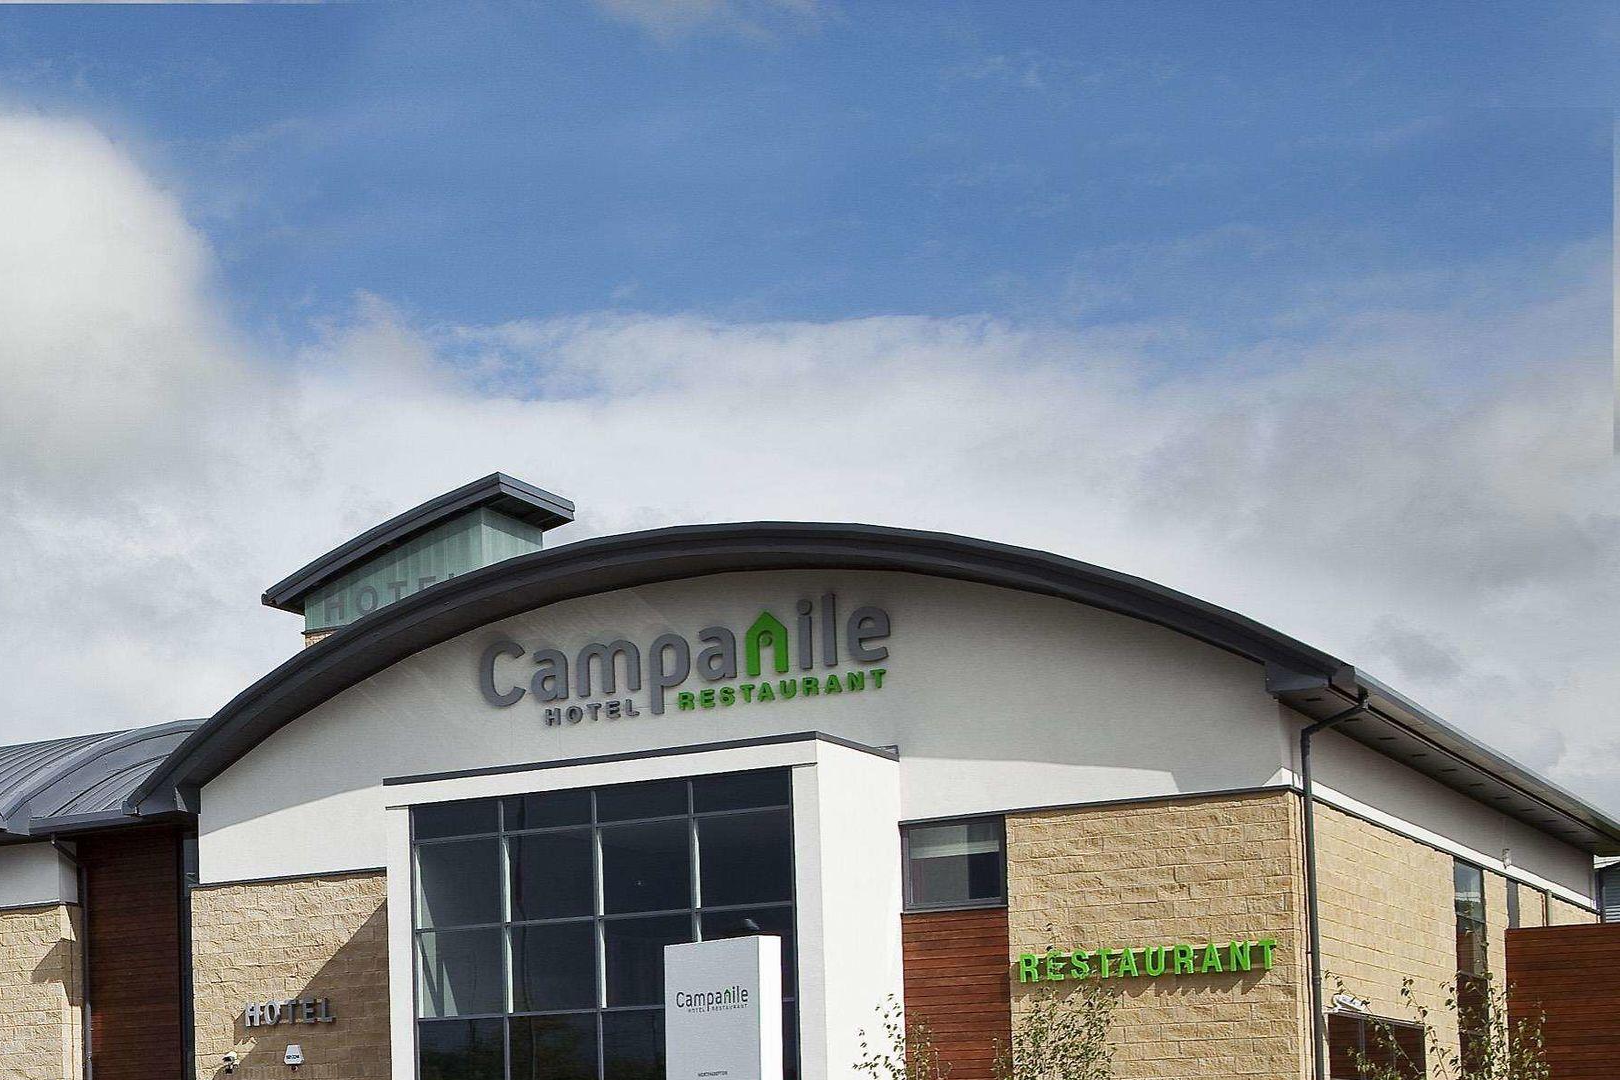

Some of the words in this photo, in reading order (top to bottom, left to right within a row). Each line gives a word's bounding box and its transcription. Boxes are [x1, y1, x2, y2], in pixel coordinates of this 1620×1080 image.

[323, 573, 455, 621] HOT
[480, 593, 891, 715] Campanile
[544, 699, 640, 727] HOTEL
[678, 668, 888, 711] RESTAURANT
[1018, 938, 1277, 983] RESTAURANT
[244, 997, 336, 1027] HOTEL
[676, 985, 749, 1012] Campanile
